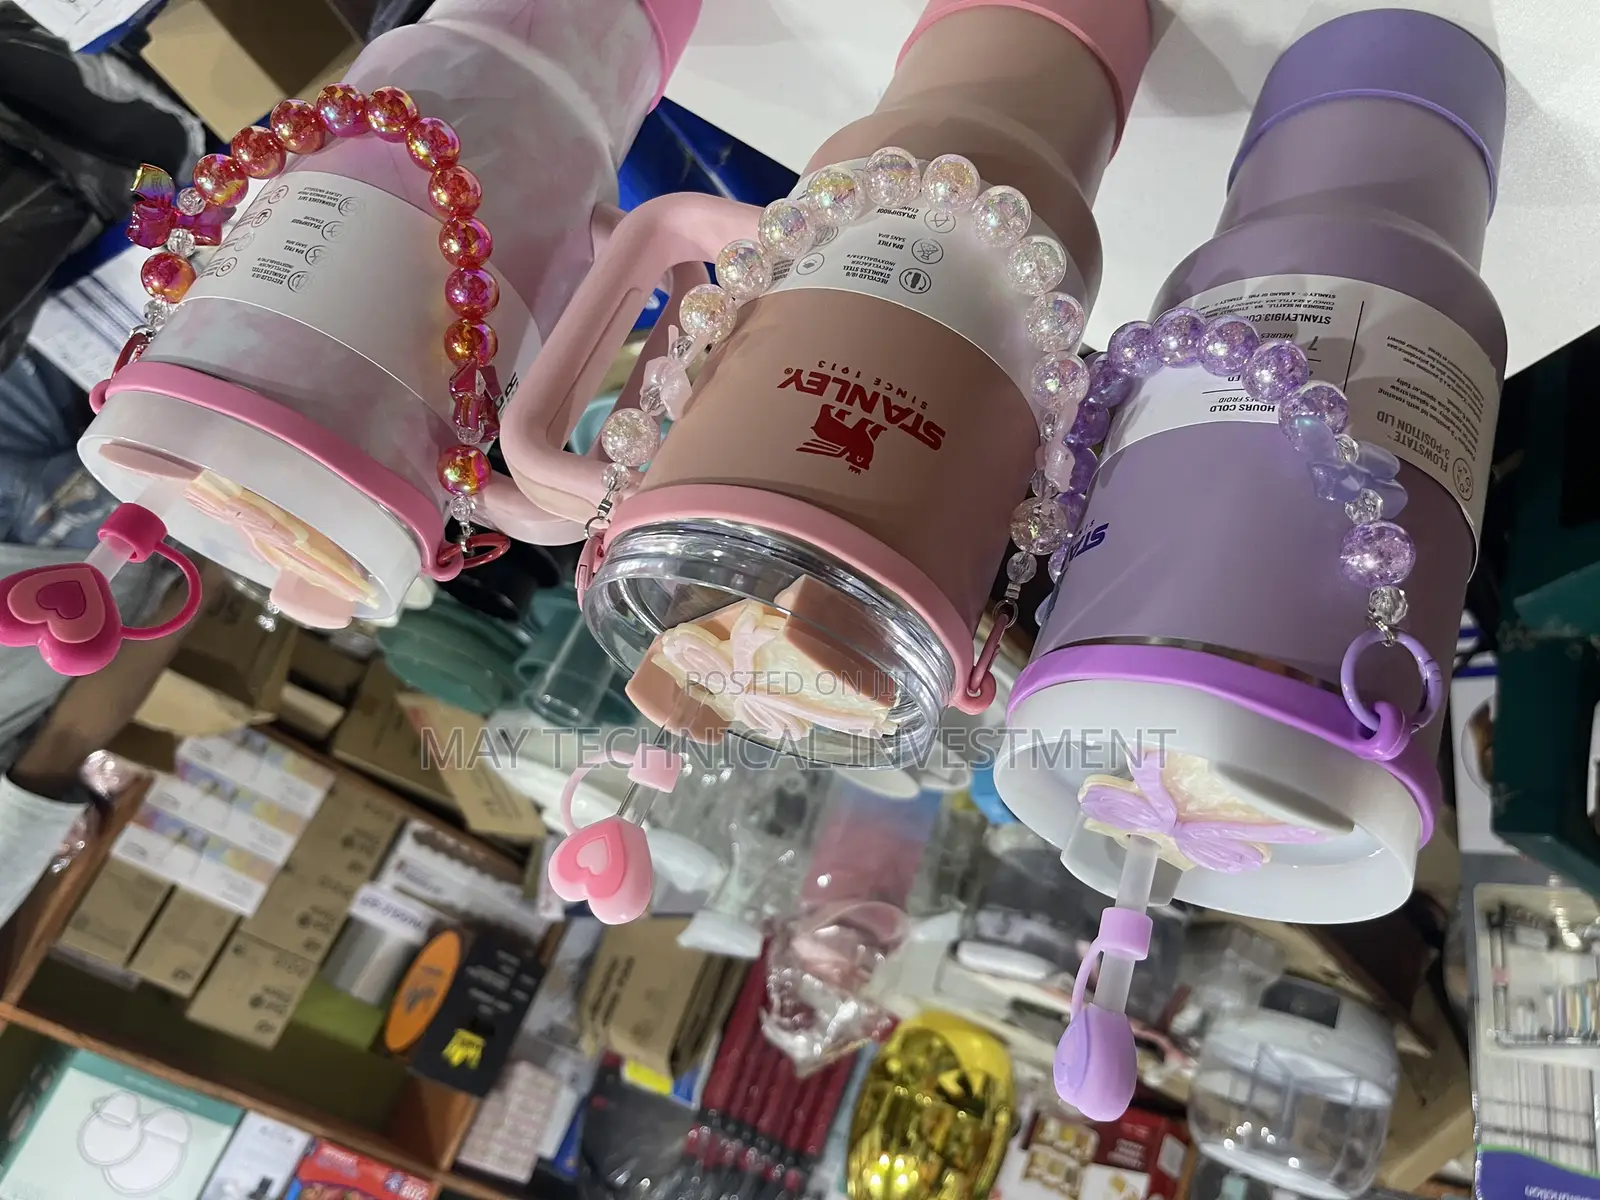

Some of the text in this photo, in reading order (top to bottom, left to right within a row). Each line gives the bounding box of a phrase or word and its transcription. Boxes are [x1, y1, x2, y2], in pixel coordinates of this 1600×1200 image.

[891, 242, 904, 250] BPA
[859, 273, 889, 285] RECYCLED
[860, 267, 892, 279] STAINLESS
[1301, 303, 1334, 311] DESIGNED
[817, 360, 928, 410] SINCE 1913
[1209, 403, 1276, 412] HOURS COLD
[1376, 411, 1395, 427] LID
[1397, 419, 1450, 460] 3-POSITION
[1393, 431, 1449, 473] FLOWSTATE
